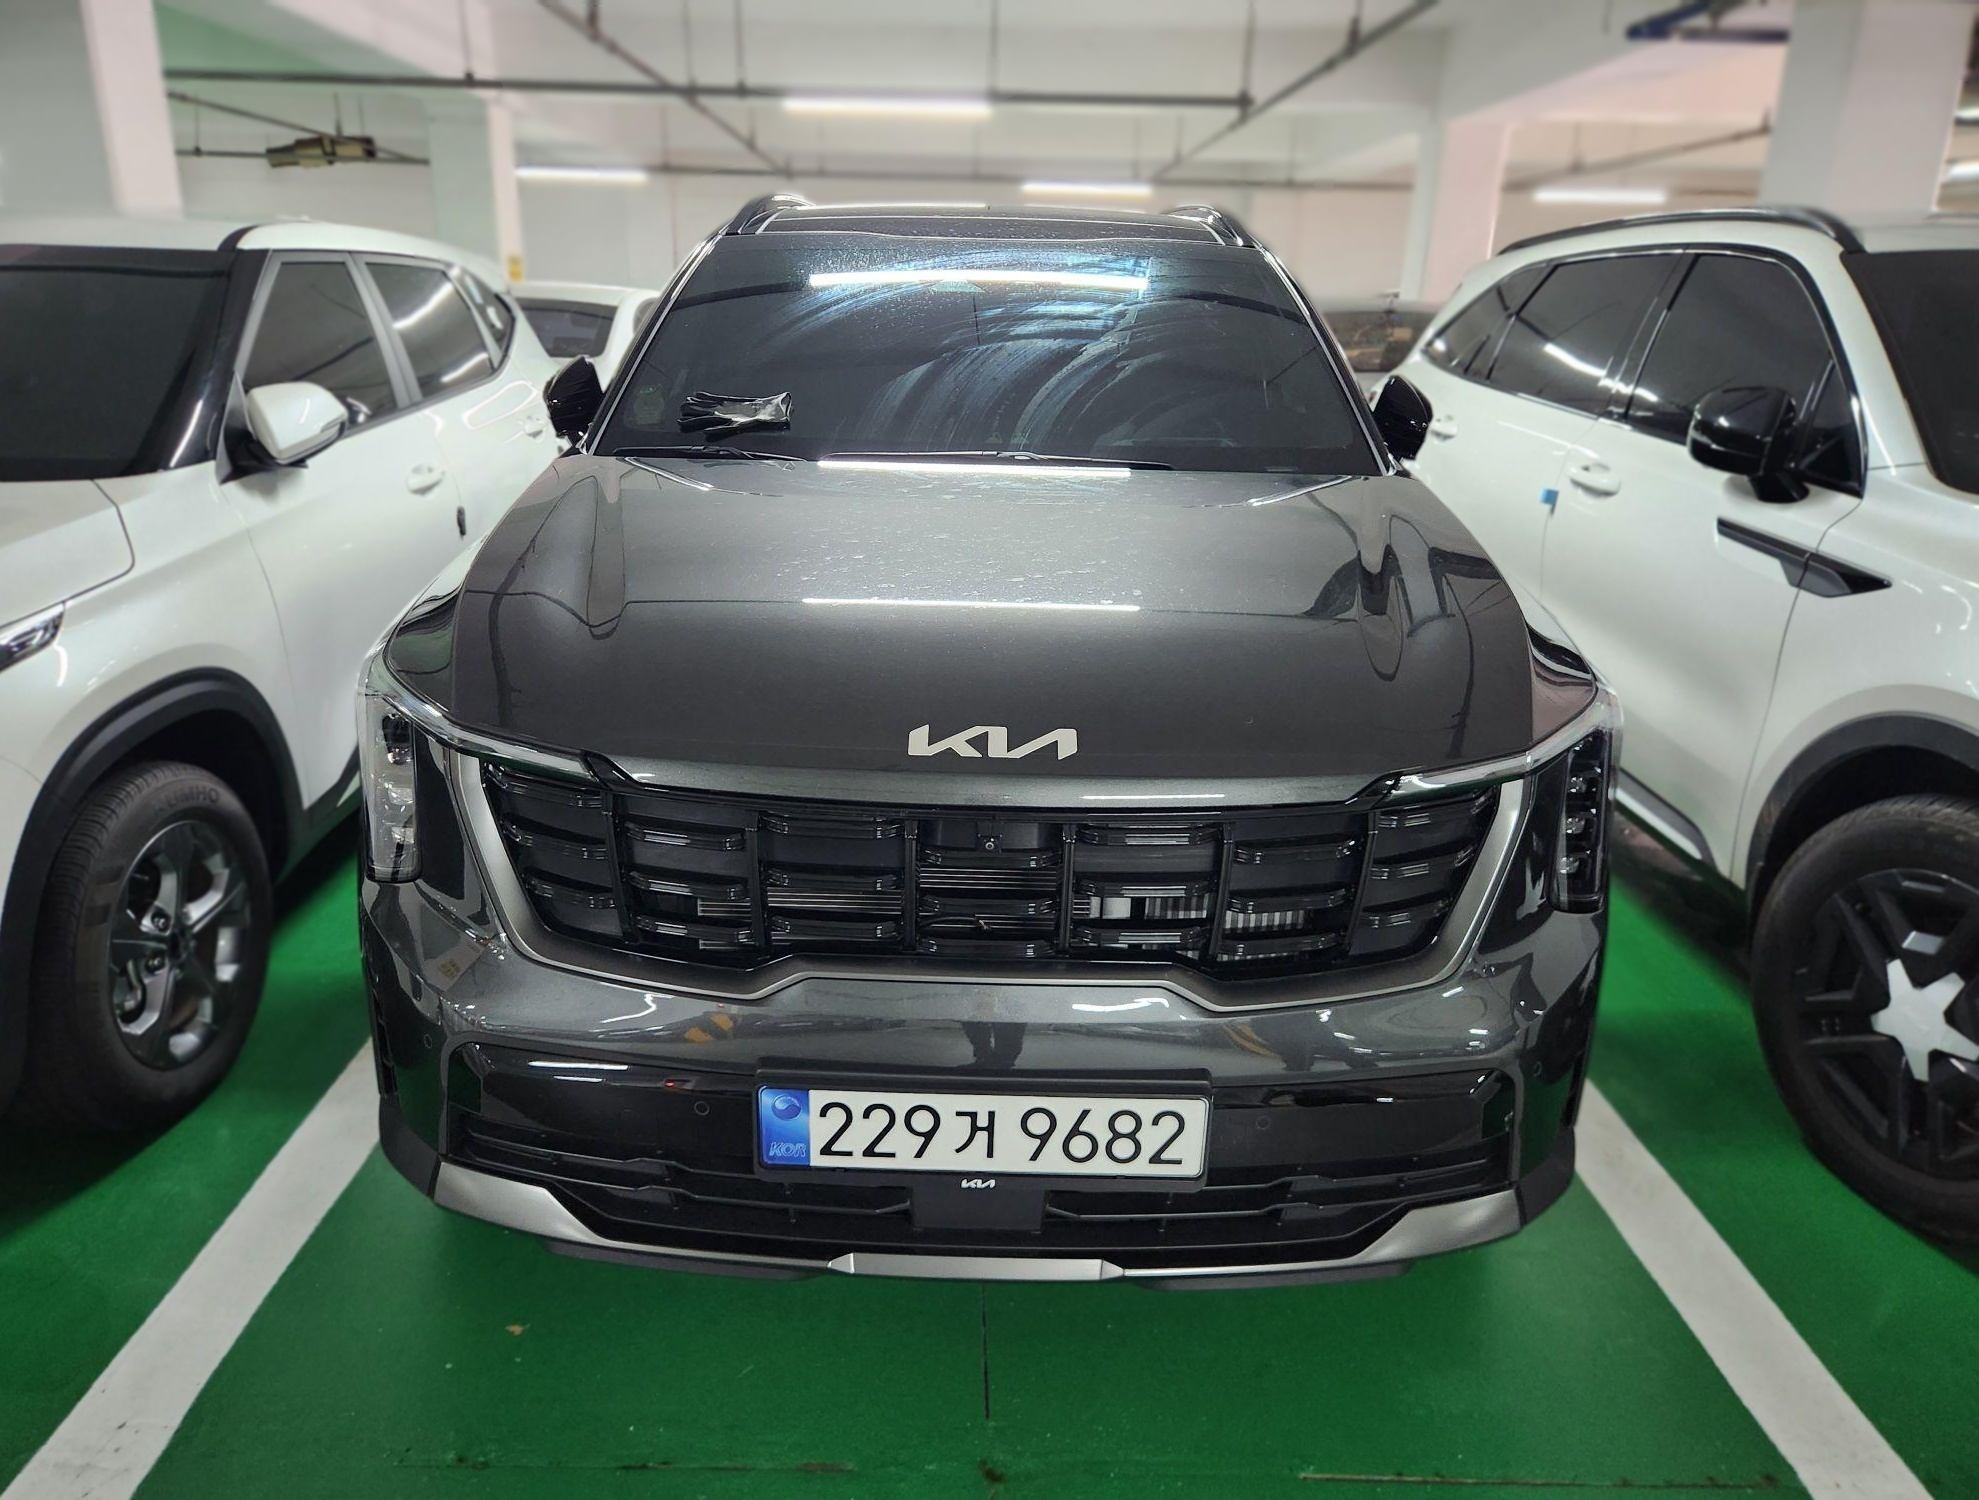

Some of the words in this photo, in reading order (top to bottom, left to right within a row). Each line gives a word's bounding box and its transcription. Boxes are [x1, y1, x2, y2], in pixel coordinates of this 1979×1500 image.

[907, 724, 1078, 761] KIA
[818, 1101, 996, 1159] 229거
[1020, 1107, 1186, 1165] 9682
[769, 1141, 807, 1157] KOR
[961, 1178, 996, 1189] KIA
